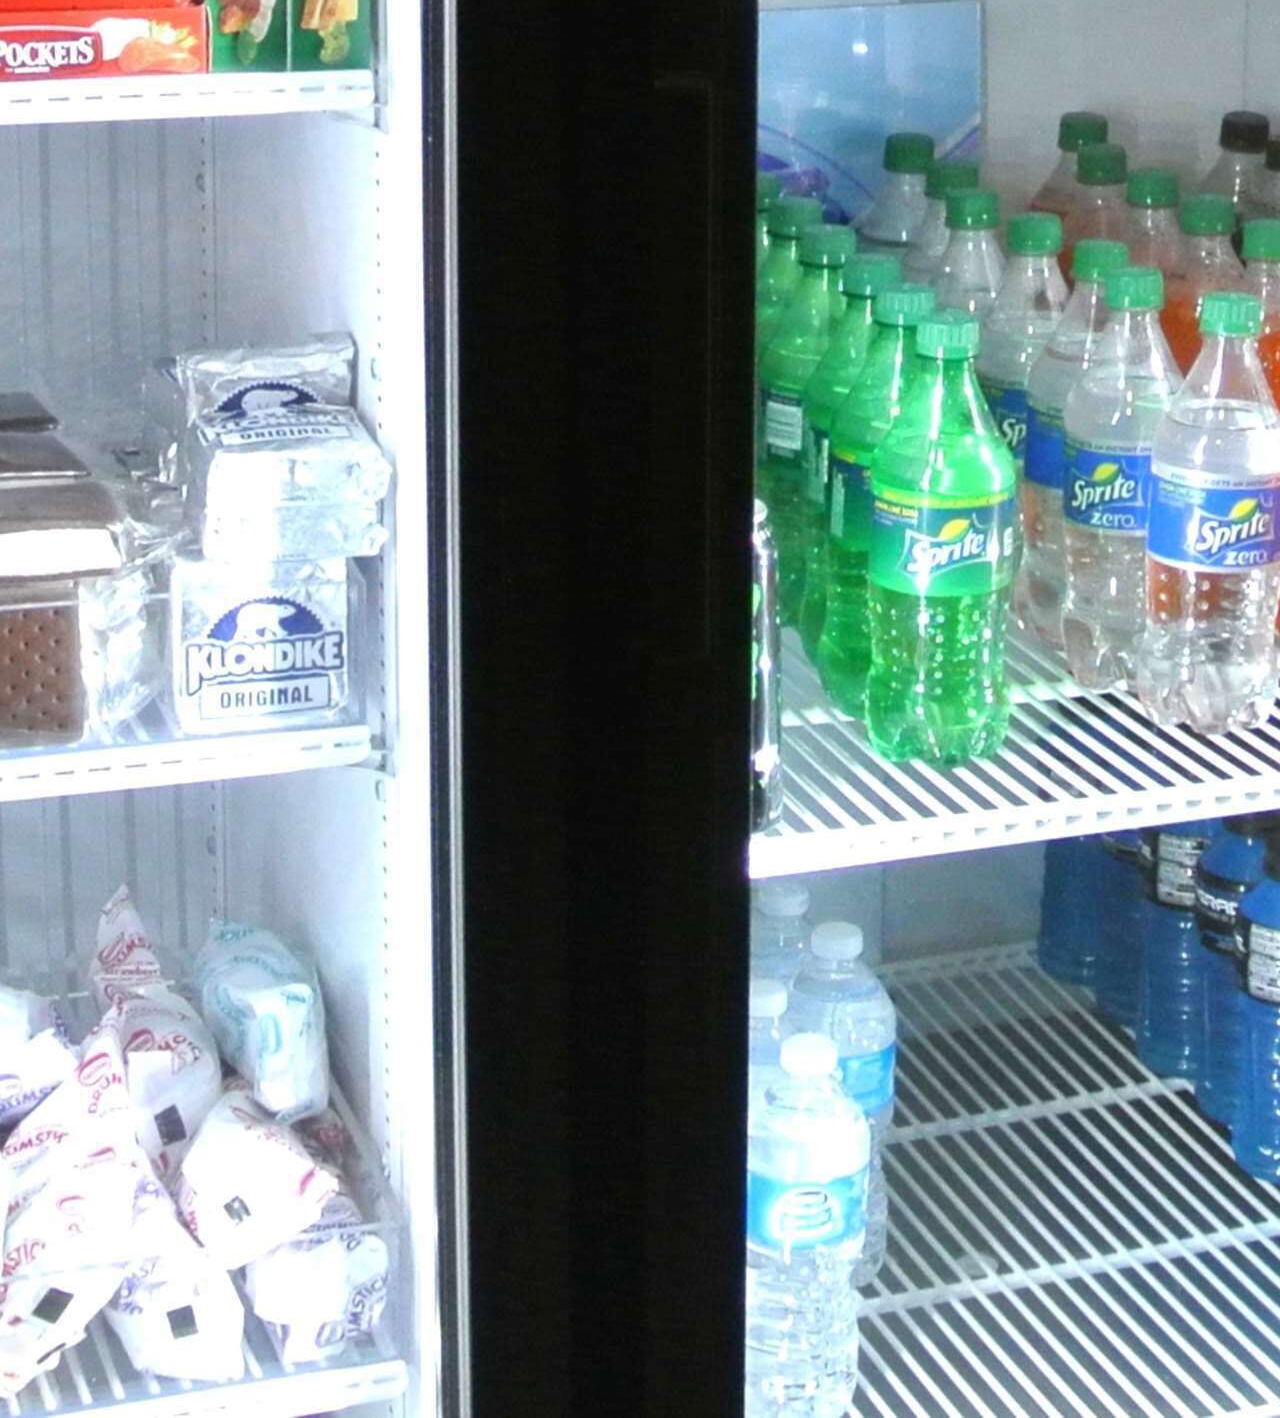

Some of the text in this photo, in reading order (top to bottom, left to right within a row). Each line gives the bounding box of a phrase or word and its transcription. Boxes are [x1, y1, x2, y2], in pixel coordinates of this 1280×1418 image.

[1071, 472, 1136, 510] Sprite
[1090, 511, 1135, 527] zero
[1195, 508, 1269, 553] Sprite
[906, 527, 985, 574] Sprite
[1223, 548, 1267, 566] zero
[186, 630, 345, 696] KLONDIKE
[219, 686, 315, 709] ORIGINAL
